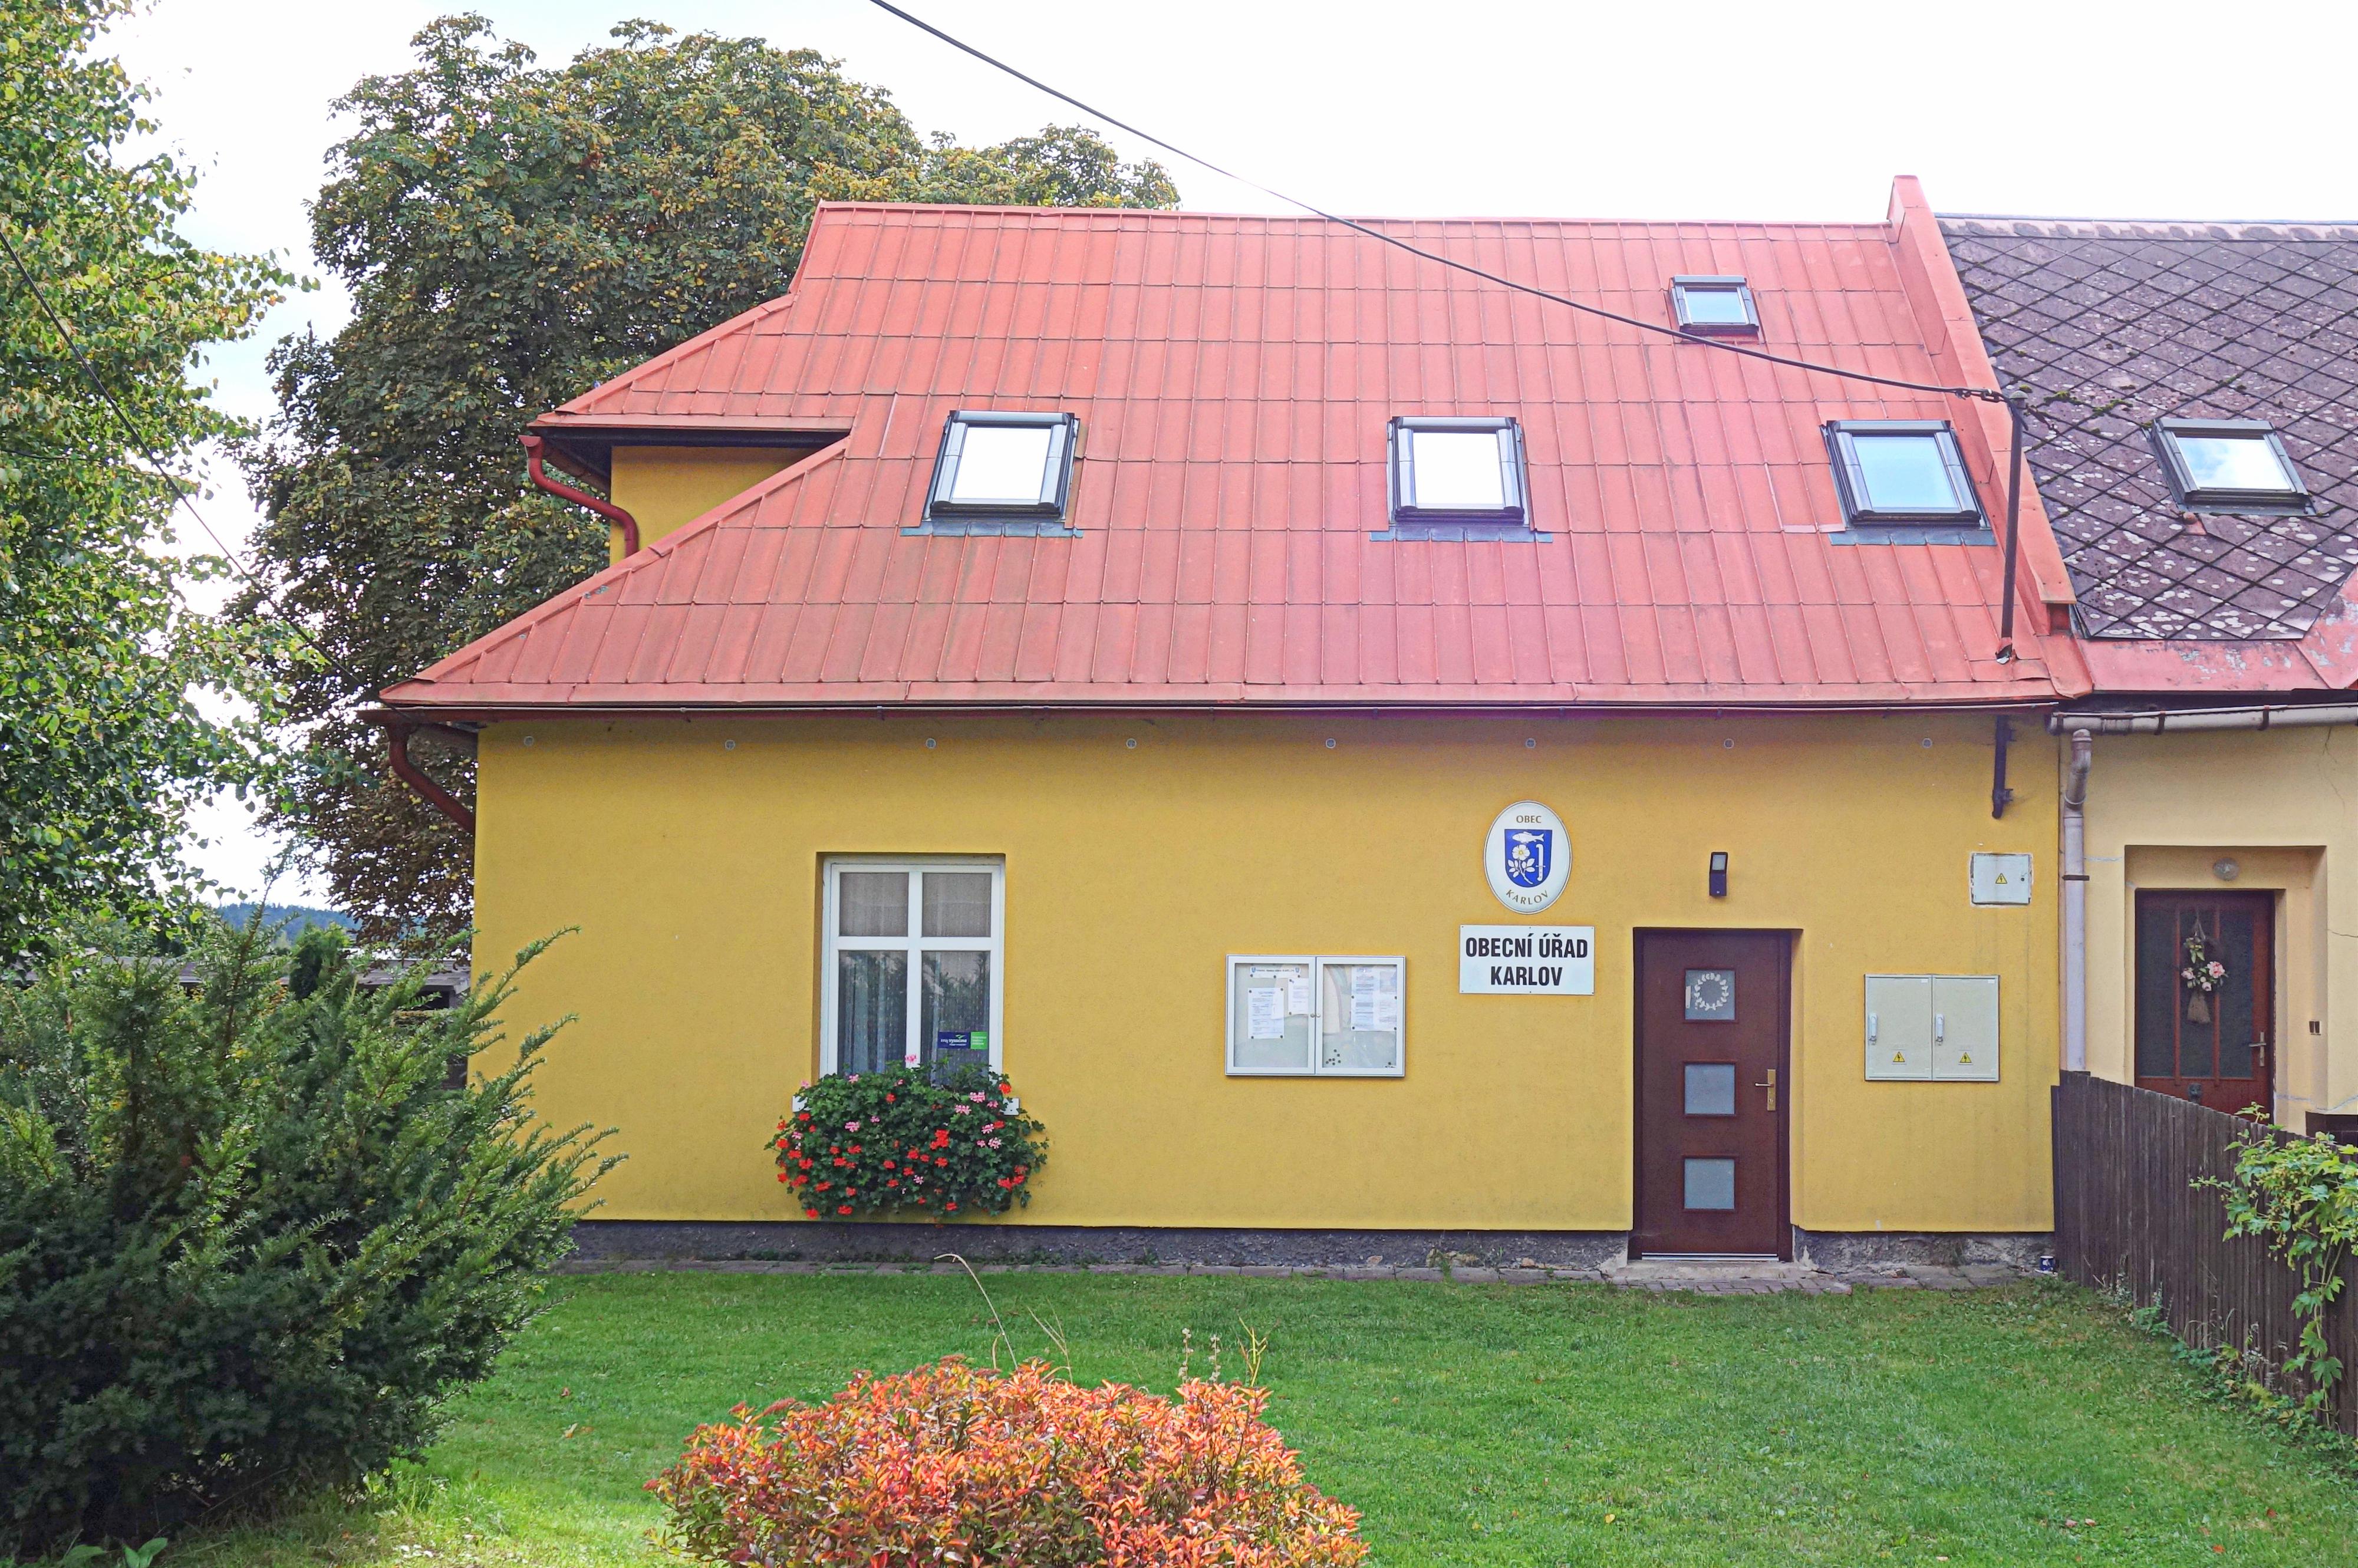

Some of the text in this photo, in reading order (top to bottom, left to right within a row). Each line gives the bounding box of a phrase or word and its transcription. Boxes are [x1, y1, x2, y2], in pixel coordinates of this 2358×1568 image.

[1516, 815, 1542, 823] OBEC
[1506, 889, 1549, 905] KARLOV
[1465, 933, 1588, 958] OBECNÍ ÚŘAD
[1490, 966, 1563, 986] KARLOV
